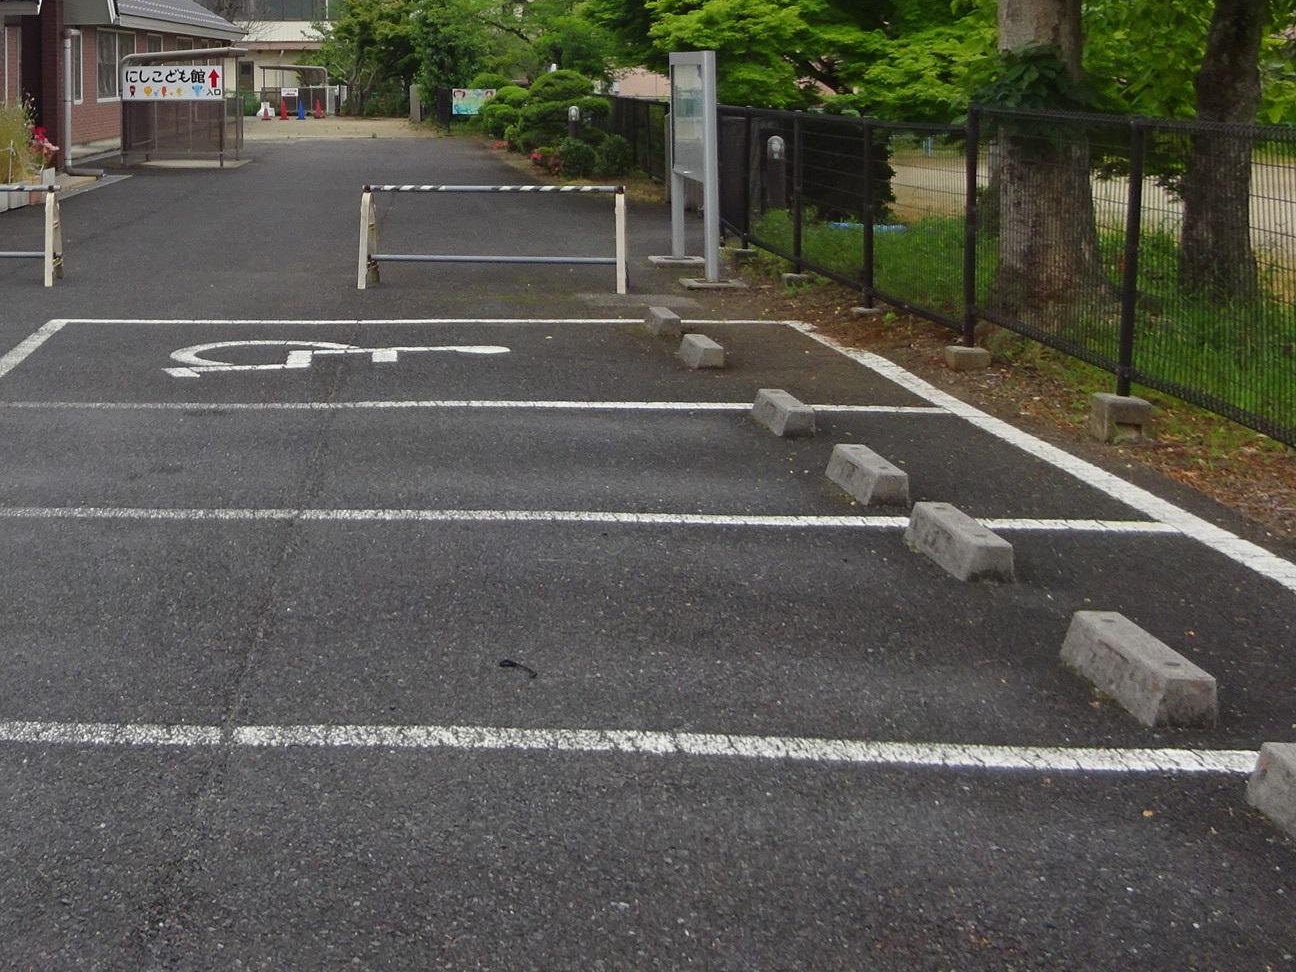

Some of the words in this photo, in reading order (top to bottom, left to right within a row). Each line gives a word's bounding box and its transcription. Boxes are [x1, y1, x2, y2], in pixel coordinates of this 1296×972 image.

[125, 69, 206, 84] にしこども館
